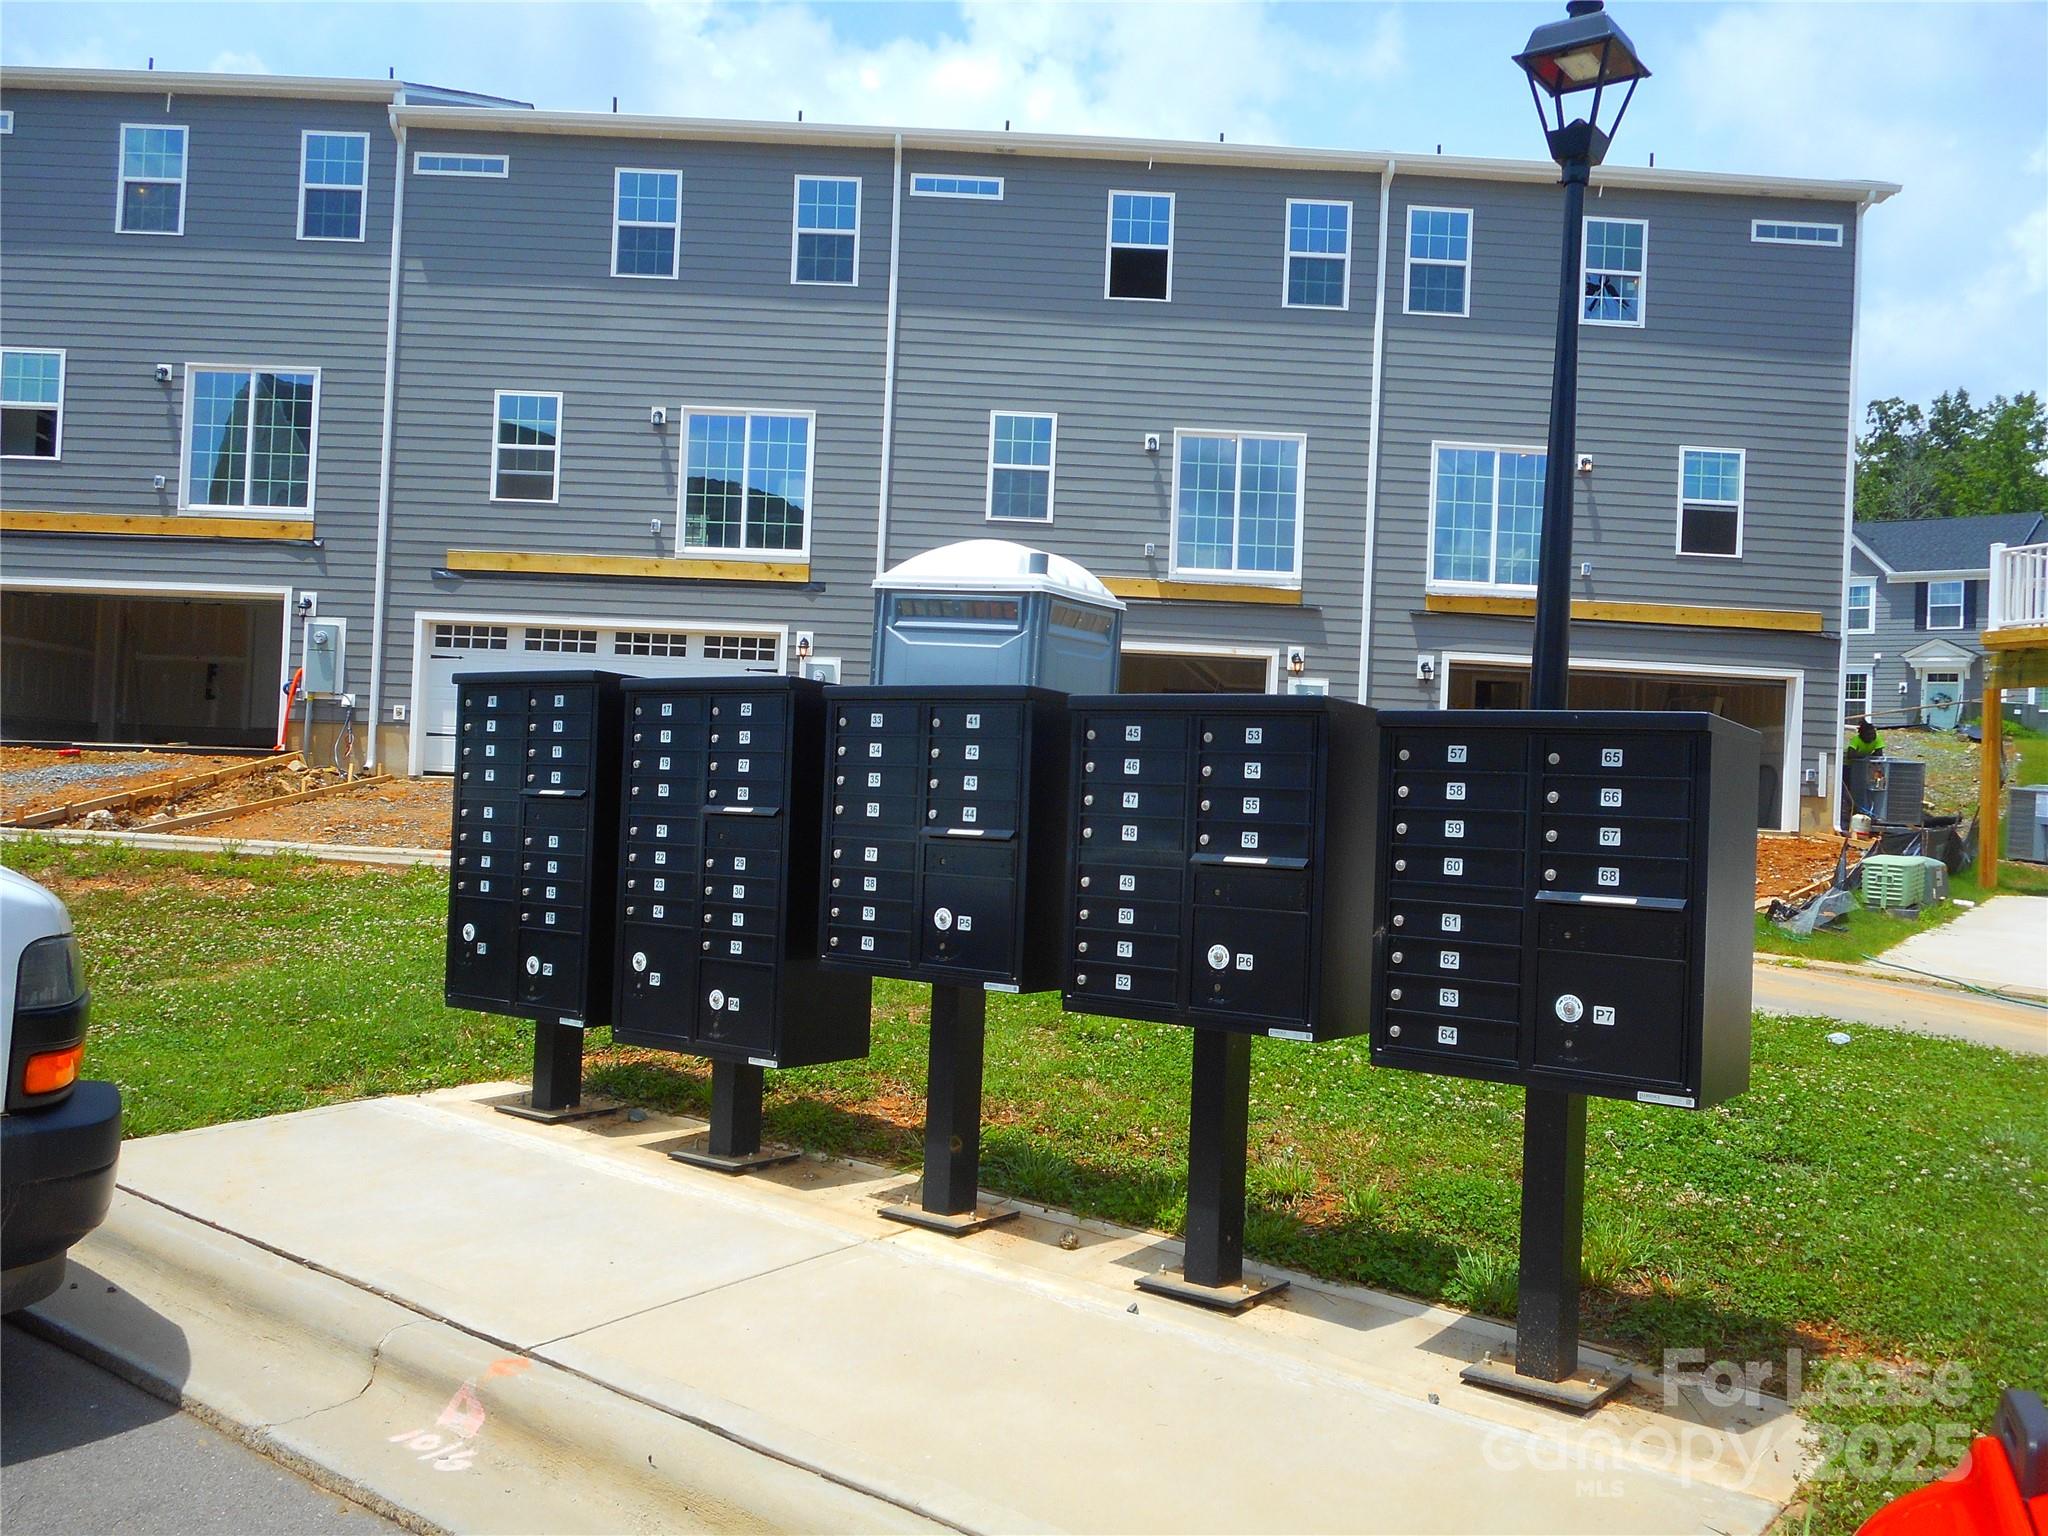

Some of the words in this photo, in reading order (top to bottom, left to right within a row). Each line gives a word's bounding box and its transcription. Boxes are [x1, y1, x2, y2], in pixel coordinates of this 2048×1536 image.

[489, 697, 496, 705] 1
[555, 697, 562, 705] 9
[663, 705, 671, 713] 17
[742, 704, 751, 714] 25
[872, 715, 882, 725] 33
[968, 716, 978, 726] 41
[488, 721, 495, 730] 2
[554, 721, 562, 730] 10
[662, 731, 670, 741] 18
[740, 732, 749, 742] 26
[1127, 727, 1139, 739] 45
[1247, 729, 1260, 742] 53
[487, 746, 494, 755] 3
[553, 747, 561, 756] 11
[871, 745, 880, 754] 34
[967, 747, 978, 757] 42
[1450, 747, 1465, 760] 57
[1604, 750, 1620, 764] 65
[661, 758, 669, 768] 19
[739, 760, 748, 770] 27
[1125, 760, 1138, 772] 46
[1246, 763, 1259, 776] 54
[487, 771, 494, 779] 4
[552, 773, 560, 782] 12
[870, 774, 880, 784] 35
[965, 777, 976, 788] 43
[659, 785, 668, 794] 20
[739, 788, 748, 798] 28
[1449, 783, 1463, 797] 58
[1124, 793, 1137, 806] 47
[1603, 790, 1620, 804] 66
[868, 804, 878, 814] 36
[1245, 798, 1258, 811] 55
[484, 808, 491, 817] 5
[964, 809, 975, 818] 44
[658, 826, 666, 835] 21
[1123, 826, 1136, 839] 48
[1447, 821, 1462, 835] 59
[484, 832, 491, 841] 6
[1243, 832, 1256, 846] 56
[1602, 829, 1619, 843] 67
[550, 837, 557, 846] 13
[656, 852, 665, 862] 22
[866, 849, 876, 859] 37
[481, 857, 488, 865] 7
[735, 858, 745, 868] 29
[1446, 859, 1461, 873] 60
[549, 863, 556, 871] 14
[1601, 869, 1618, 883] 68
[481, 882, 488, 890] 8
[655, 880, 664, 889] 23
[865, 878, 875, 888] 38
[1121, 876, 1133, 889] 49
[547, 888, 555, 897] 15
[734, 886, 743, 896] 30
[654, 906, 662, 915] 24
[864, 908, 874, 918] 39
[1120, 909, 1132, 922] 50
[547, 913, 554, 922] 16
[733, 914, 742, 924] 31
[1444, 915, 1457, 929] 61
[959, 918, 971, 928] P5
[732, 942, 741, 952] 32
[863, 938, 873, 948] 40
[477, 944, 486, 953] P1
[1119, 942, 1130, 955] 51
[1238, 955, 1252, 969] P6
[1442, 952, 1457, 967] 62
[543, 965, 552, 974] P2
[650, 974, 660, 984] P3
[1117, 975, 1129, 988] 52
[1442, 990, 1457, 1004] 63
[729, 999, 739, 1009] P4
[1595, 1008, 1613, 1023] P7
[1440, 1027, 1455, 1042] 64
